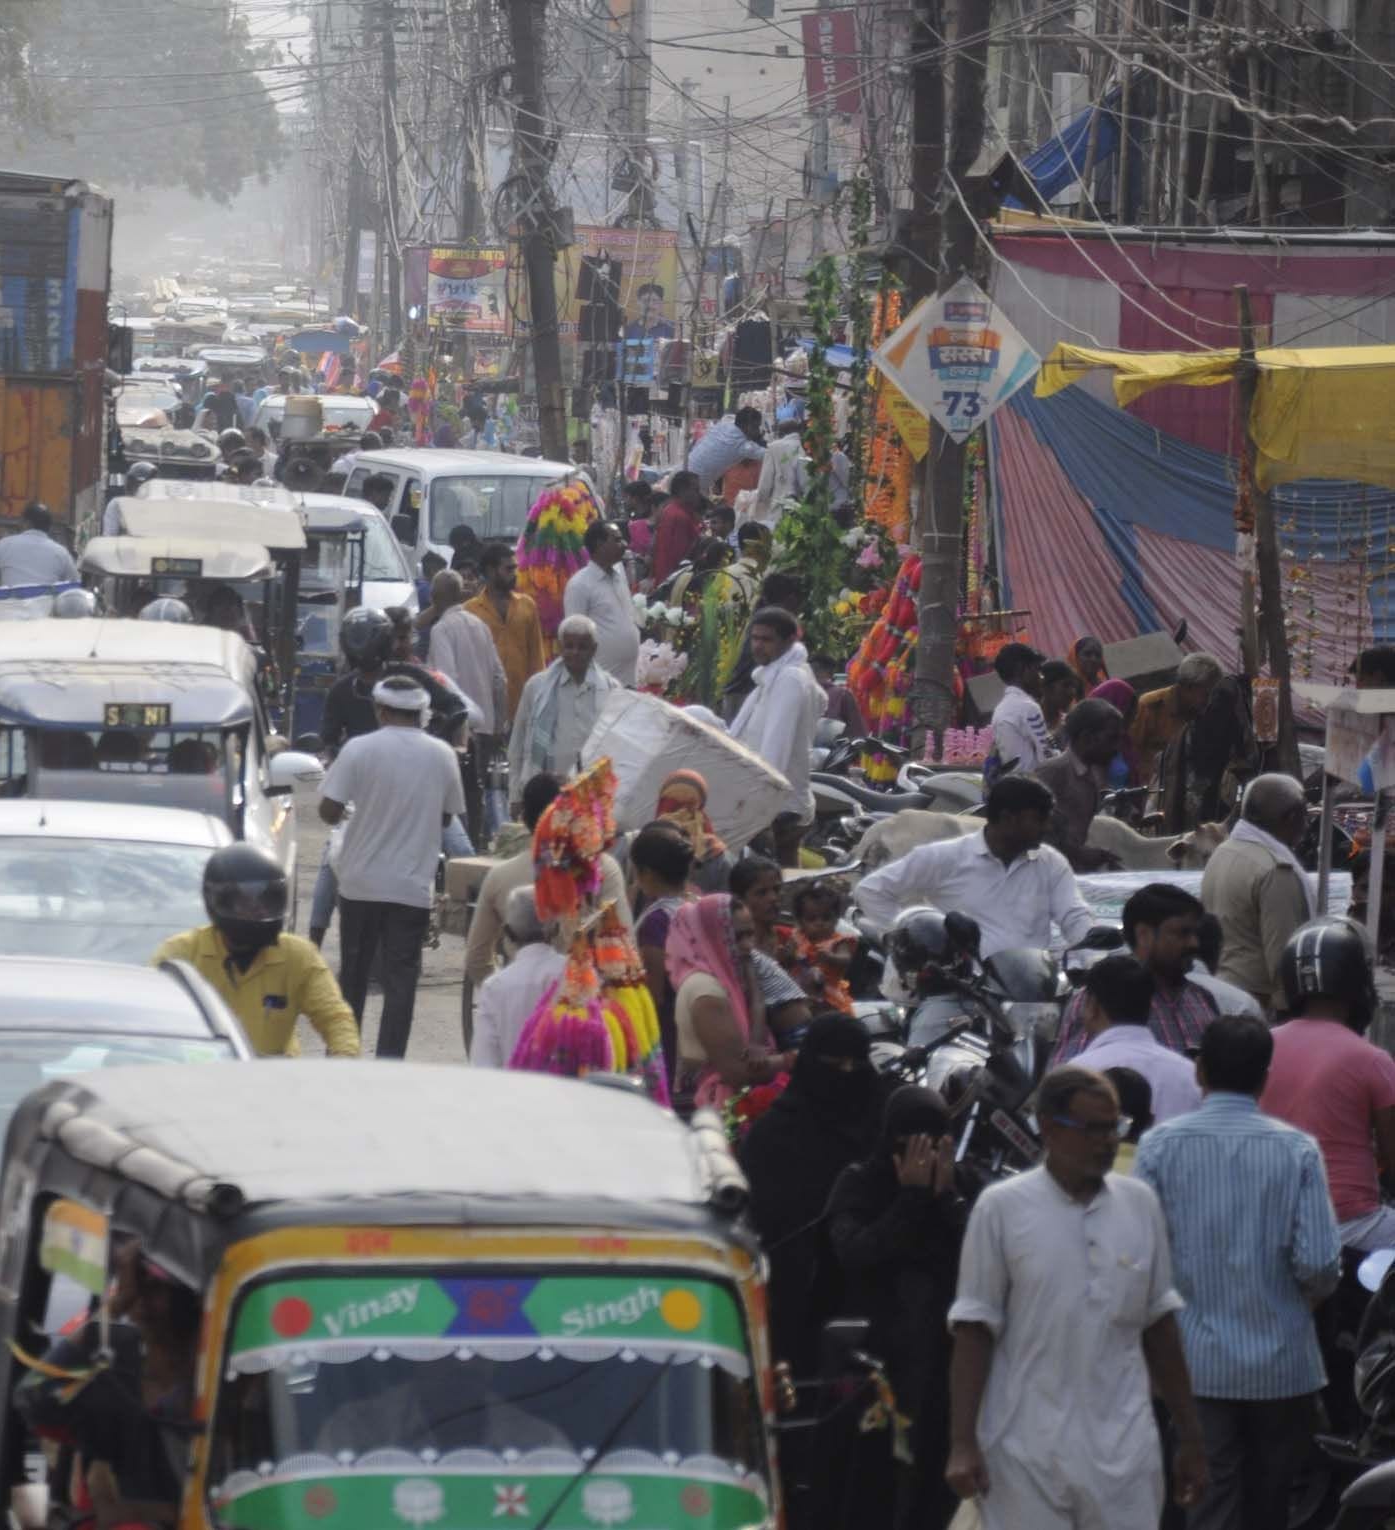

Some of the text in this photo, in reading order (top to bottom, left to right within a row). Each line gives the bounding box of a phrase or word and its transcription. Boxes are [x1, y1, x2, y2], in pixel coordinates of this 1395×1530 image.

[942, 391, 981, 418] 73
[322, 1283, 422, 1338] Vinay
[561, 1285, 661, 1337] Singh
